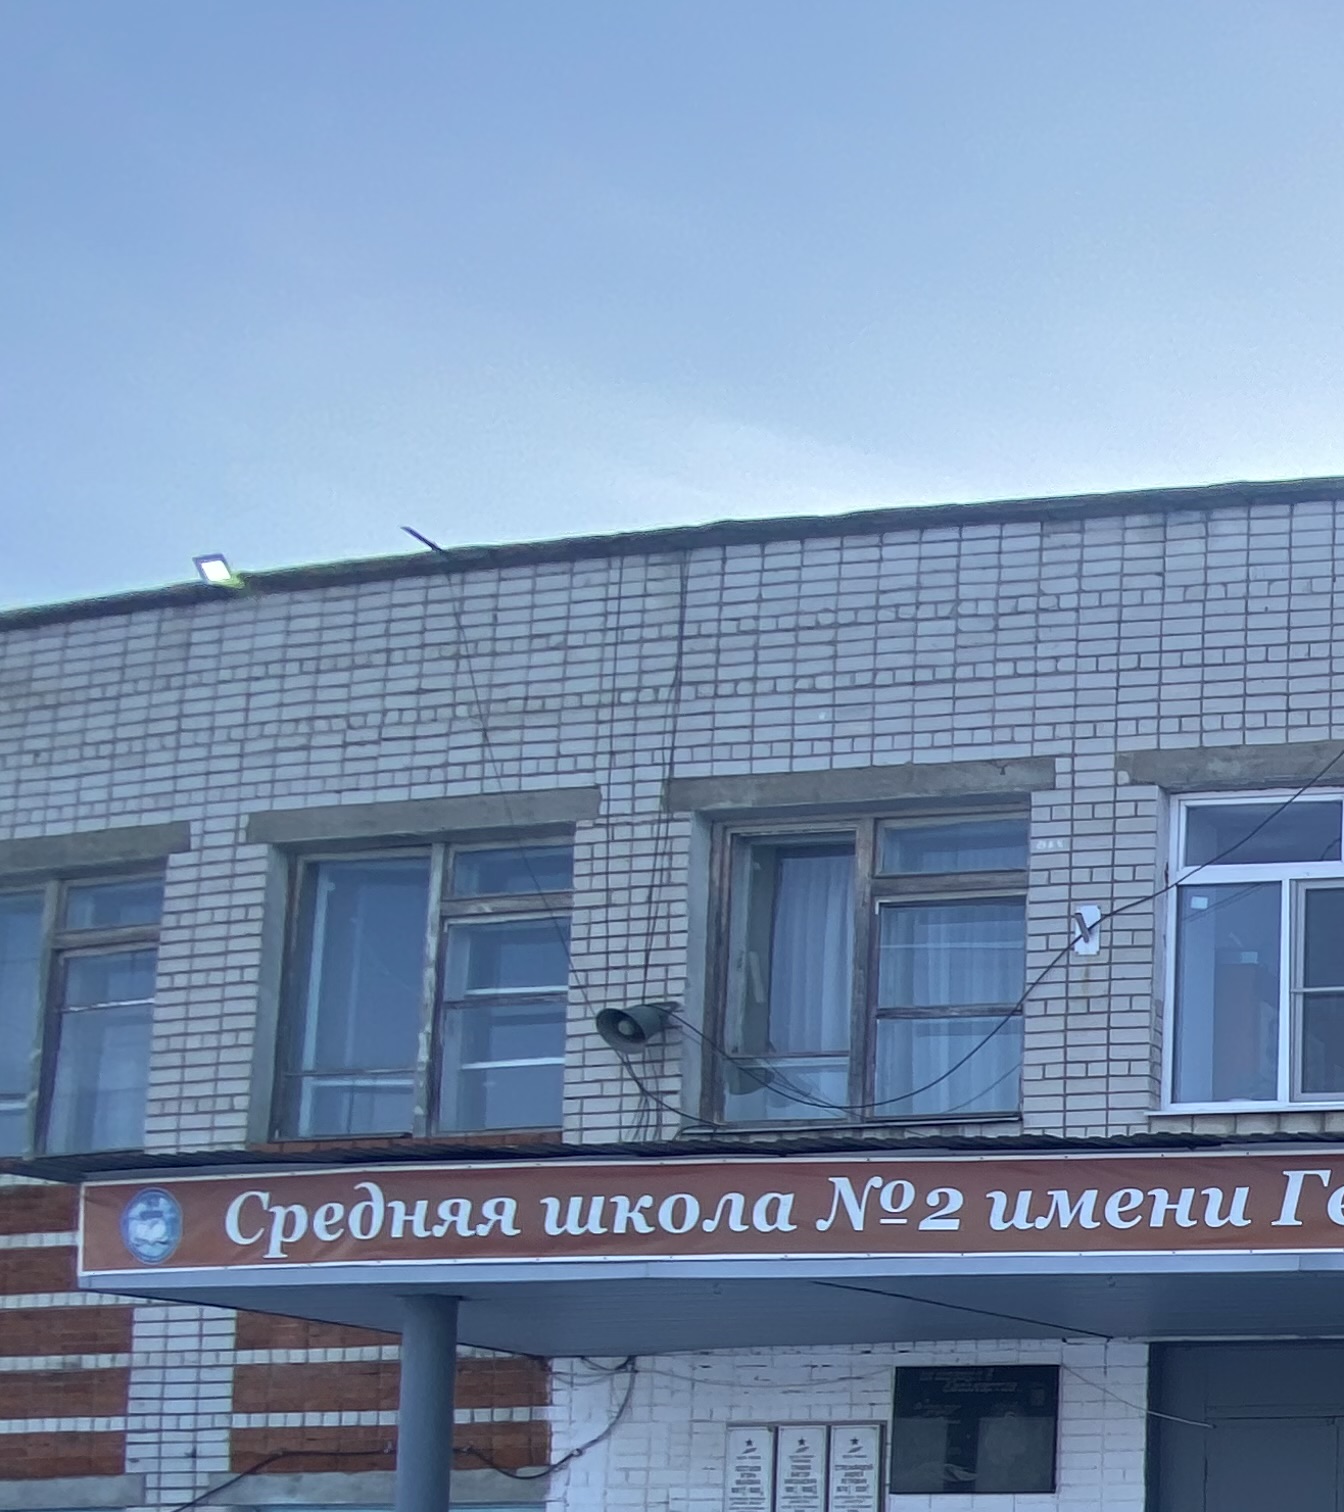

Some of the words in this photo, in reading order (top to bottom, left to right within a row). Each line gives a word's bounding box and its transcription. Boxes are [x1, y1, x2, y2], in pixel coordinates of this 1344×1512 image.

[225, 1182, 521, 1259] Средняя
[543, 1189, 798, 1235] школа
[816, 1175, 964, 1233] №2
[989, 1184, 1254, 1231] имени
